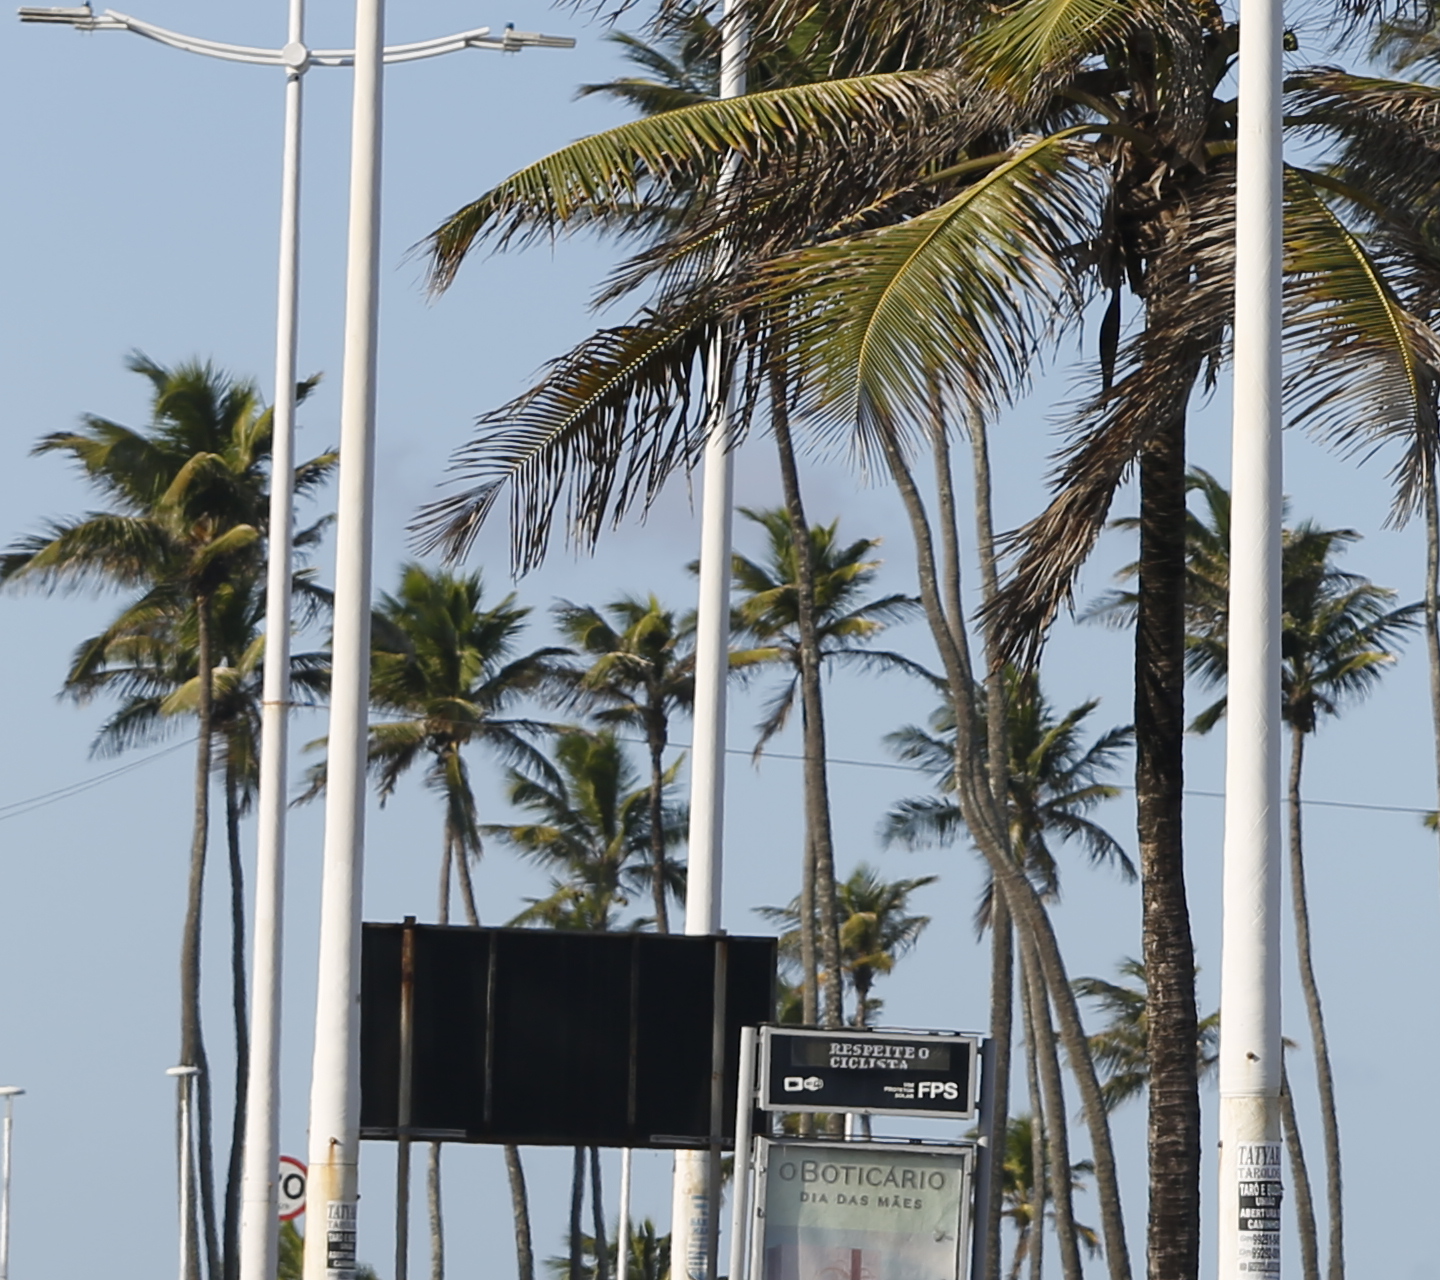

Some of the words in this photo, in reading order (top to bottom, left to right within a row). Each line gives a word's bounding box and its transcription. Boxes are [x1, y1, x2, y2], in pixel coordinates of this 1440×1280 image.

[829, 1042, 915, 1059] RESPEITE
[918, 1047, 930, 1059] O
[830, 1057, 908, 1070] CICLISTA
[917, 1081, 959, 1100] FPS
[800, 1192, 828, 1204] DIA
[837, 1194, 869, 1206] DAS
[878, 1195, 923, 1209] MÃES
